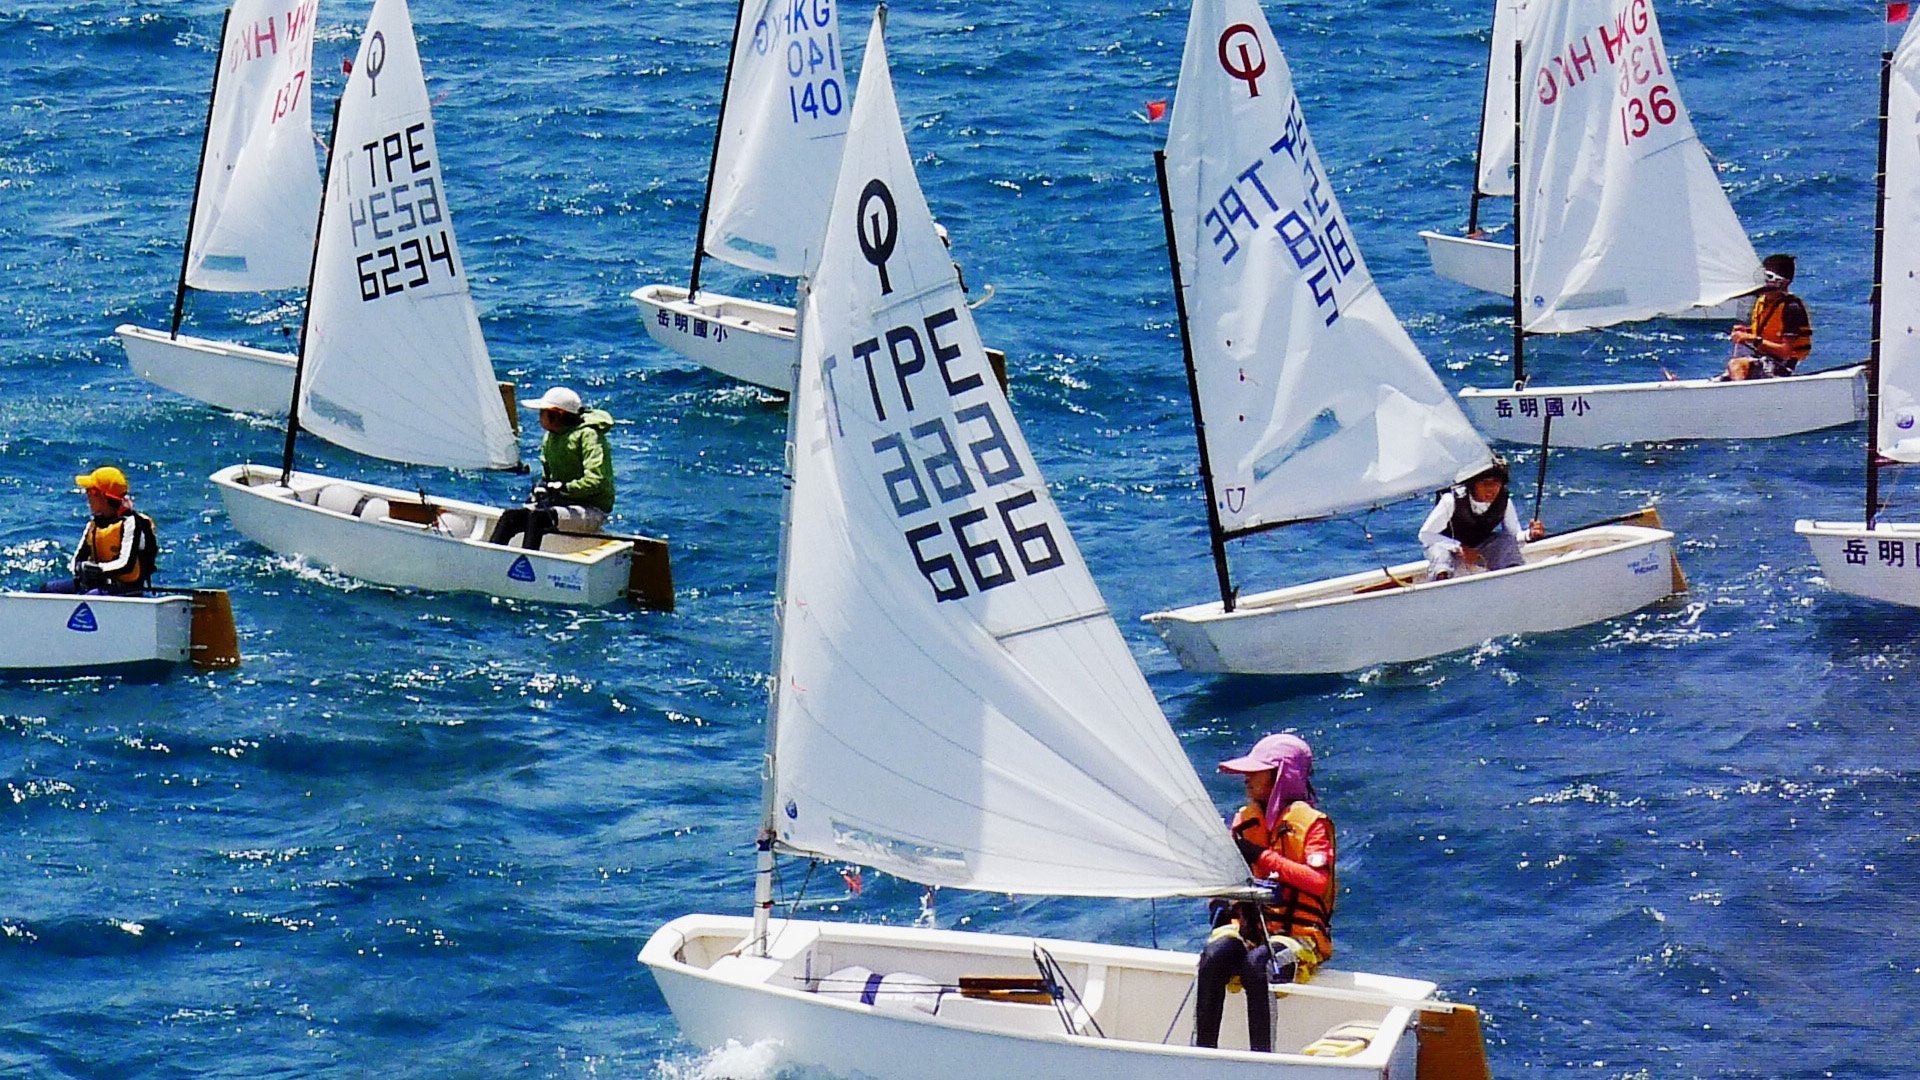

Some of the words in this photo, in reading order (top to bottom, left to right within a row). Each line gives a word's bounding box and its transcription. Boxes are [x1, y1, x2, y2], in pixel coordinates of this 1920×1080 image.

[1599, 0, 1649, 64] HKG
[271, 70, 305, 124] 137
[790, 78, 842, 123] 140
[1621, 85, 1677, 146] 136
[363, 122, 431, 187] TPE
[357, 231, 455, 301] 6234
[1307, 215, 1356, 328] 518
[656, 308, 728, 342] 岳明國小
[852, 307, 984, 421] TPE
[1495, 396, 1591, 418] 岳明國小
[905, 490, 1065, 603] 666
[1842, 540, 1920, 568] 岳明
